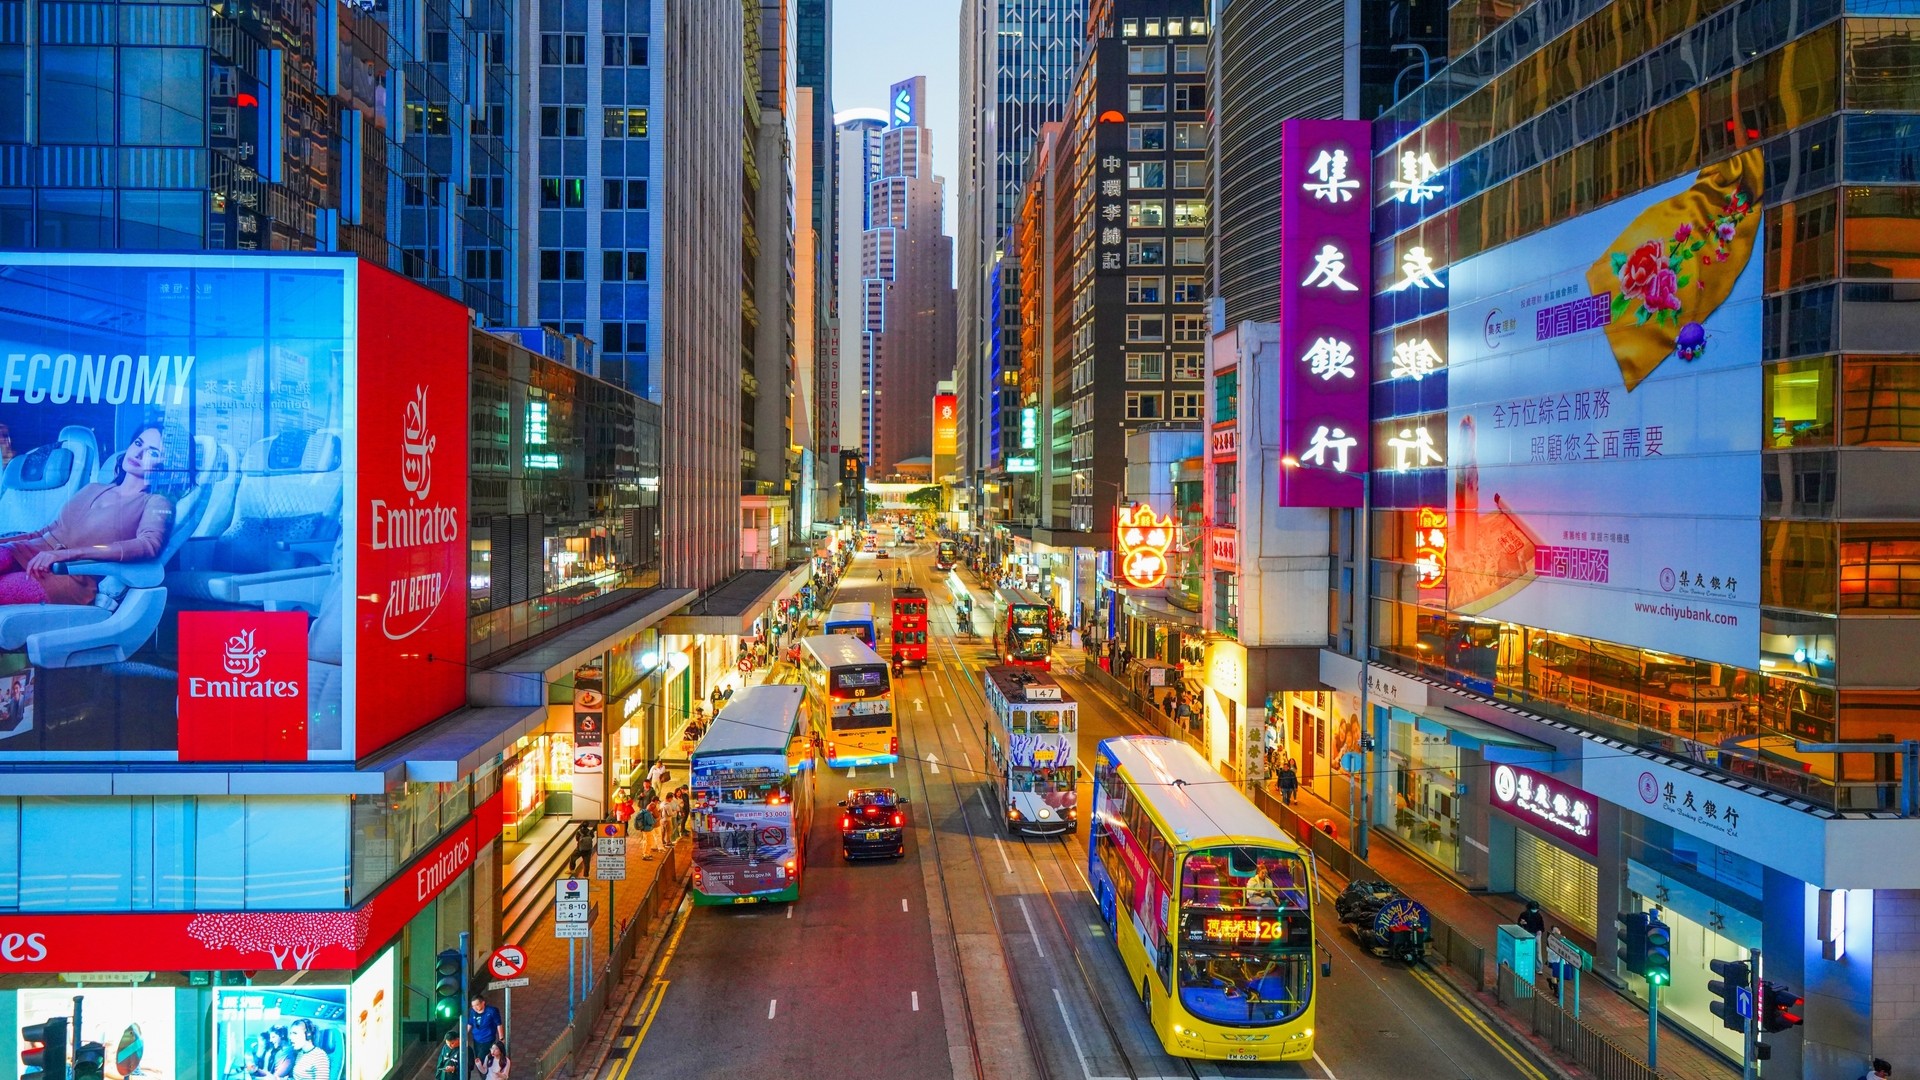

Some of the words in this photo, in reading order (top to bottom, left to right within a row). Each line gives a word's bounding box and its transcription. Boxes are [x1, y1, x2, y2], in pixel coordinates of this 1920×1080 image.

[1102, 155, 1122, 270] 中環李錦記
[1301, 149, 1361, 474] 集友銀行
[1536, 292, 1612, 341] 財富管理
[2, 353, 196, 405] ECONOMY
[1493, 388, 1611, 430] 全方位綜合服務
[1531, 425, 1664, 461] 照顧您全面需要
[371, 497, 458, 550] Emirates
[1535, 546, 1609, 583] 工商服務
[1679, 570, 1738, 593] 集友銀行
[389, 577, 407, 618] FLY
[408, 571, 443, 614] BETTER
[1634, 601, 1738, 627] www.chiyubank.com
[189, 677, 299, 698] Emirates
[854, 688, 866, 697] 619
[1034, 689, 1054, 698] 147
[733, 788, 746, 800] 101
[1663, 781, 1740, 829] 集友銀行
[417, 836, 469, 902] Emirates
[1260, 921, 1283, 939] 26
